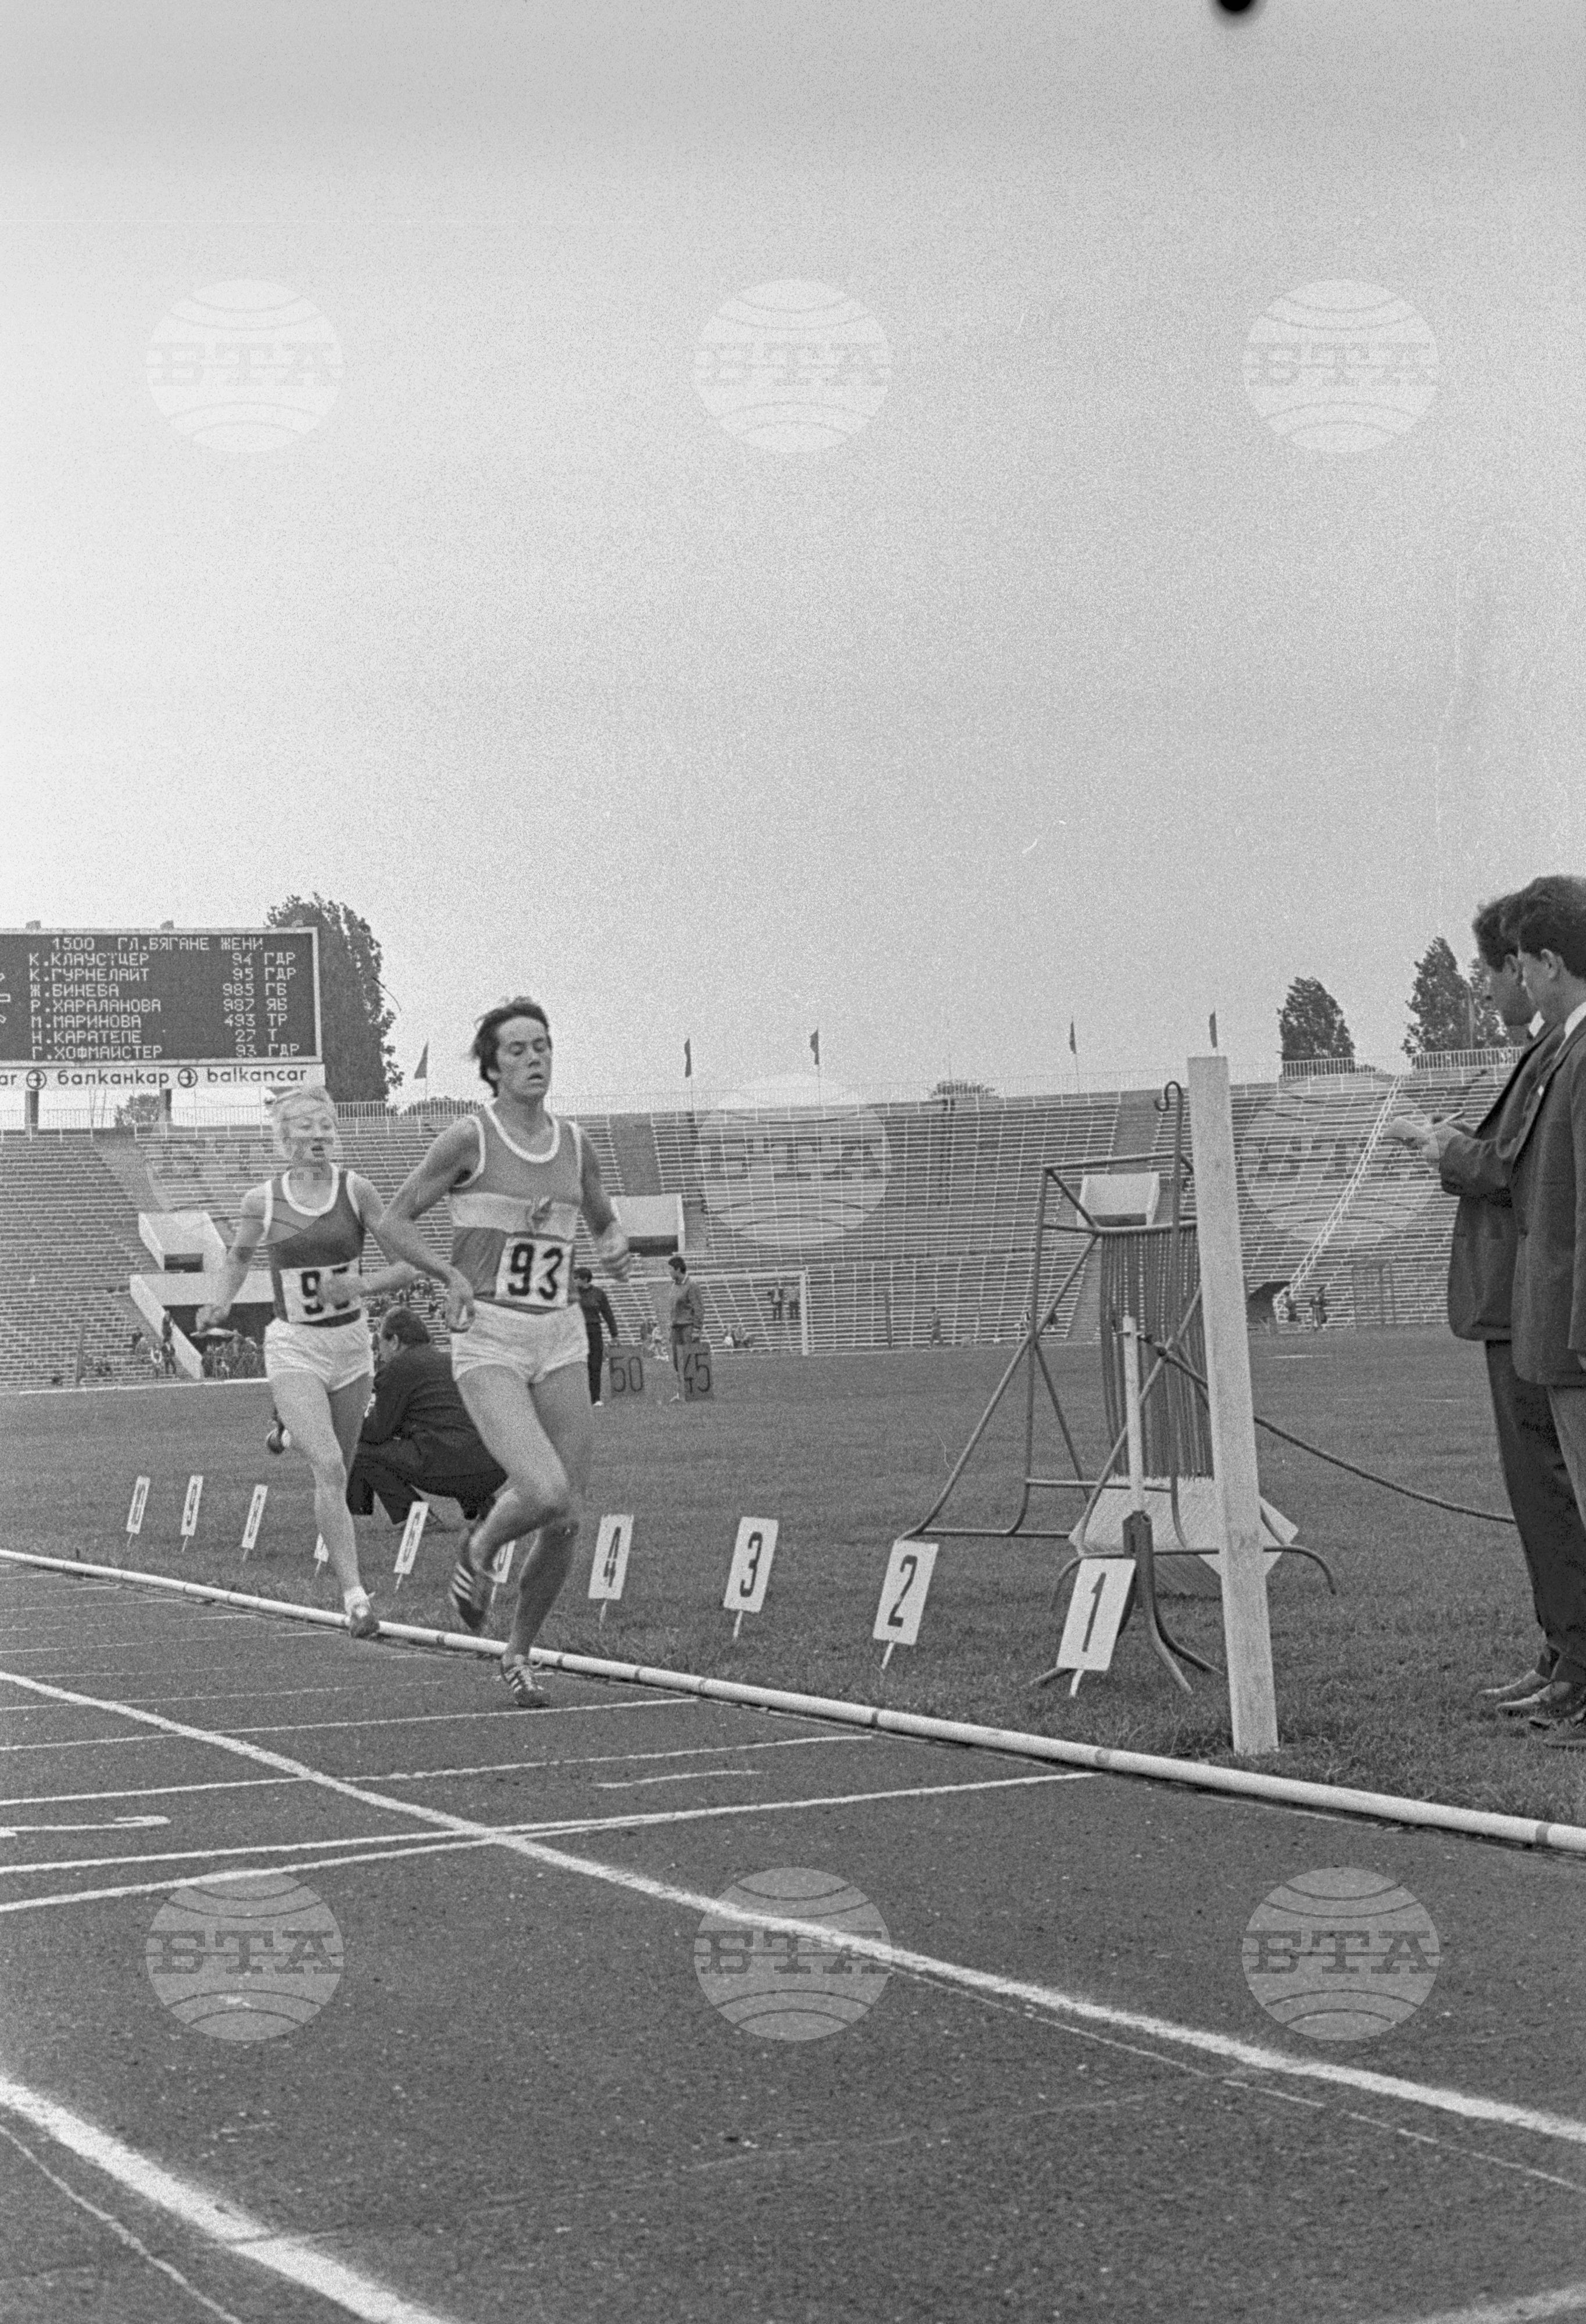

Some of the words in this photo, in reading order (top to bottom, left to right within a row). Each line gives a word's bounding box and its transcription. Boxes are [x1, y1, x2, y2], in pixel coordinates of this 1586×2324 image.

[52, 937, 95, 951] 1500
[221, 937, 263, 951] ЖЕНИ
[232, 952, 252, 965] 94
[264, 952, 296, 965] ГДР
[233, 968, 253, 981] 95
[264, 967, 296, 980] ГДР
[223, 983, 255, 996] 985
[265, 983, 287, 996] ГБ
[223, 999, 255, 1012] 987
[266, 998, 288, 1011] ЯБ
[224, 1014, 256, 1027] 493
[267, 1013, 288, 1026] ТР
[235, 1029, 256, 1042] 27
[268, 1028, 277, 1041] Т
[235, 1045, 257, 1057] 93
[268, 1043, 300, 1056] ГДР
[58, 1069, 169, 1088] балканкар
[207, 1067, 307, 1083] balkancar
[507, 1243, 563, 1301] 93
[610, 1356, 644, 1393] 50
[684, 1353, 711, 1393] 45
[603, 1526, 621, 1588] 4
[740, 1532, 763, 1597] 3
[887, 1555, 918, 1627] 2
[1082, 1572, 1107, 1652] 1
